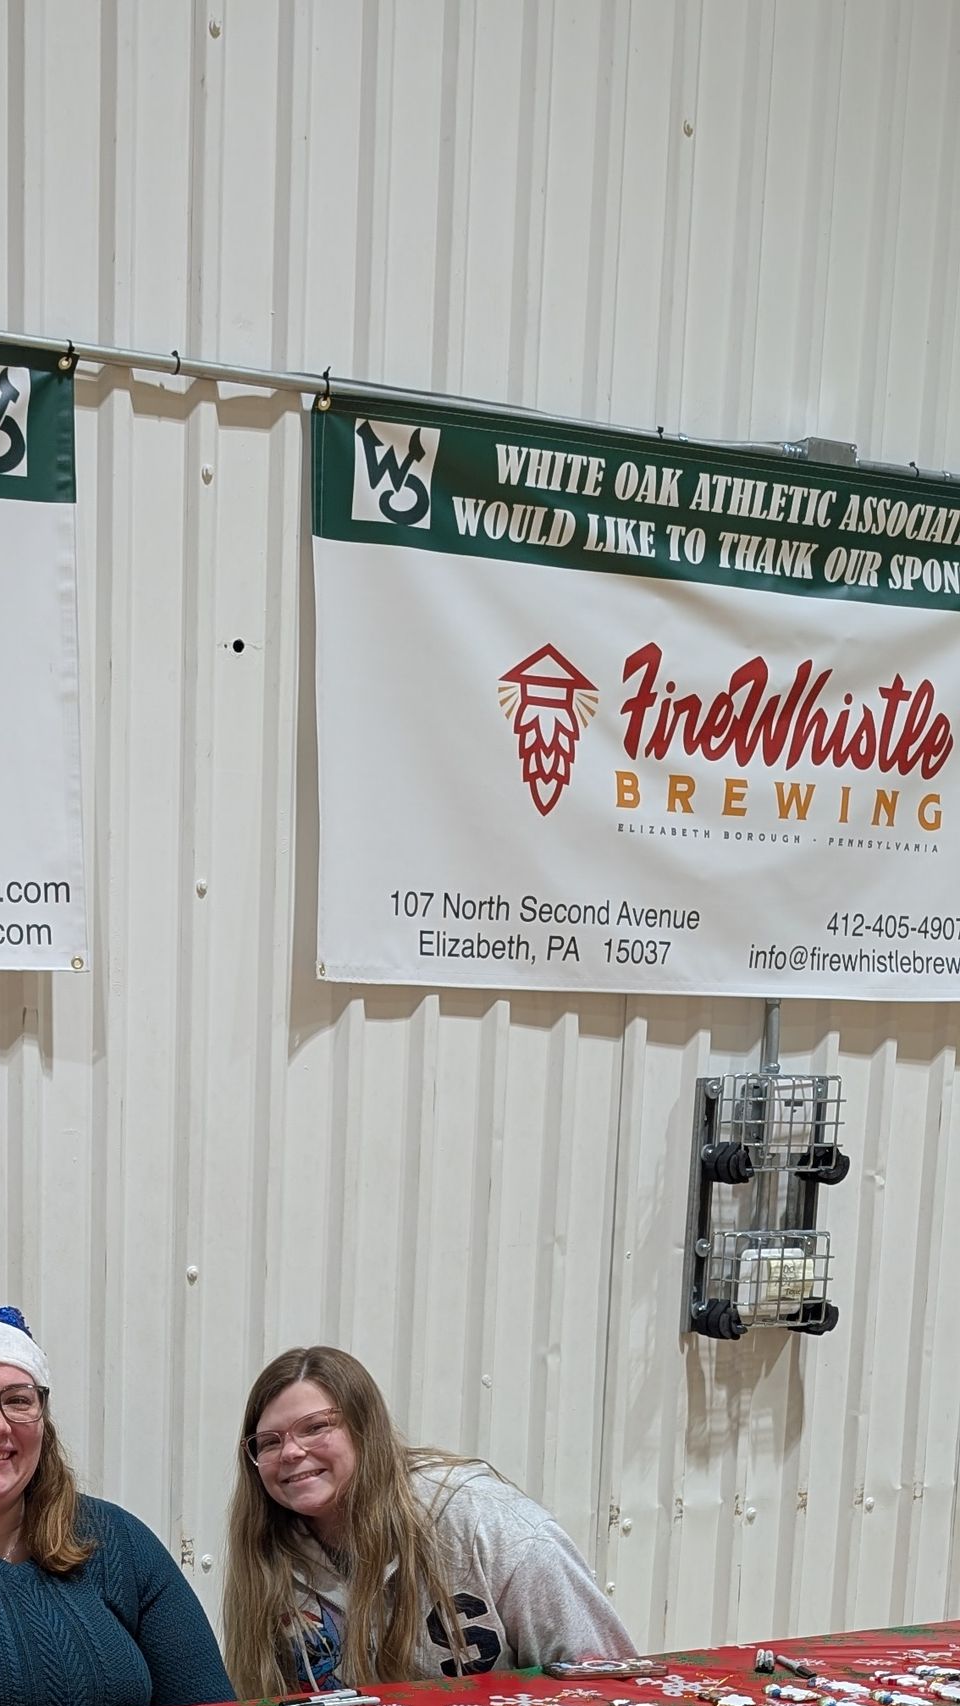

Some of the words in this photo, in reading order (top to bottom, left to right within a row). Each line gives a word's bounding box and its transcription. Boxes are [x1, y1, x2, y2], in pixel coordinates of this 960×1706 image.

[495, 443, 606, 496] WHITE
[614, 461, 682, 508] OAK
[691, 473, 837, 528] ATHLETIC
[452, 496, 576, 548] WOULD
[583, 513, 656, 559] LIKE
[666, 524, 706, 565] TO
[719, 531, 819, 580] THANK
[824, 546, 882, 587] OUR
[620, 641, 954, 781] FireWhistle
[615, 770, 943, 832] BREWING
[617, 823, 711, 839] ELIZABETH
[724, 831, 801, 844] BOROUGH
[828, 837, 939, 853] PENNSYLVANIA
[390, 890, 434, 918] 107
[442, 892, 510, 922] North
[519, 895, 610, 926] Second
[616, 903, 700, 930] Avenue
[419, 931, 537, 965] Elizabeth,
[546, 936, 580, 962] PA
[604, 938, 672, 966] 15037
[426, 1592, 502, 1678] S
